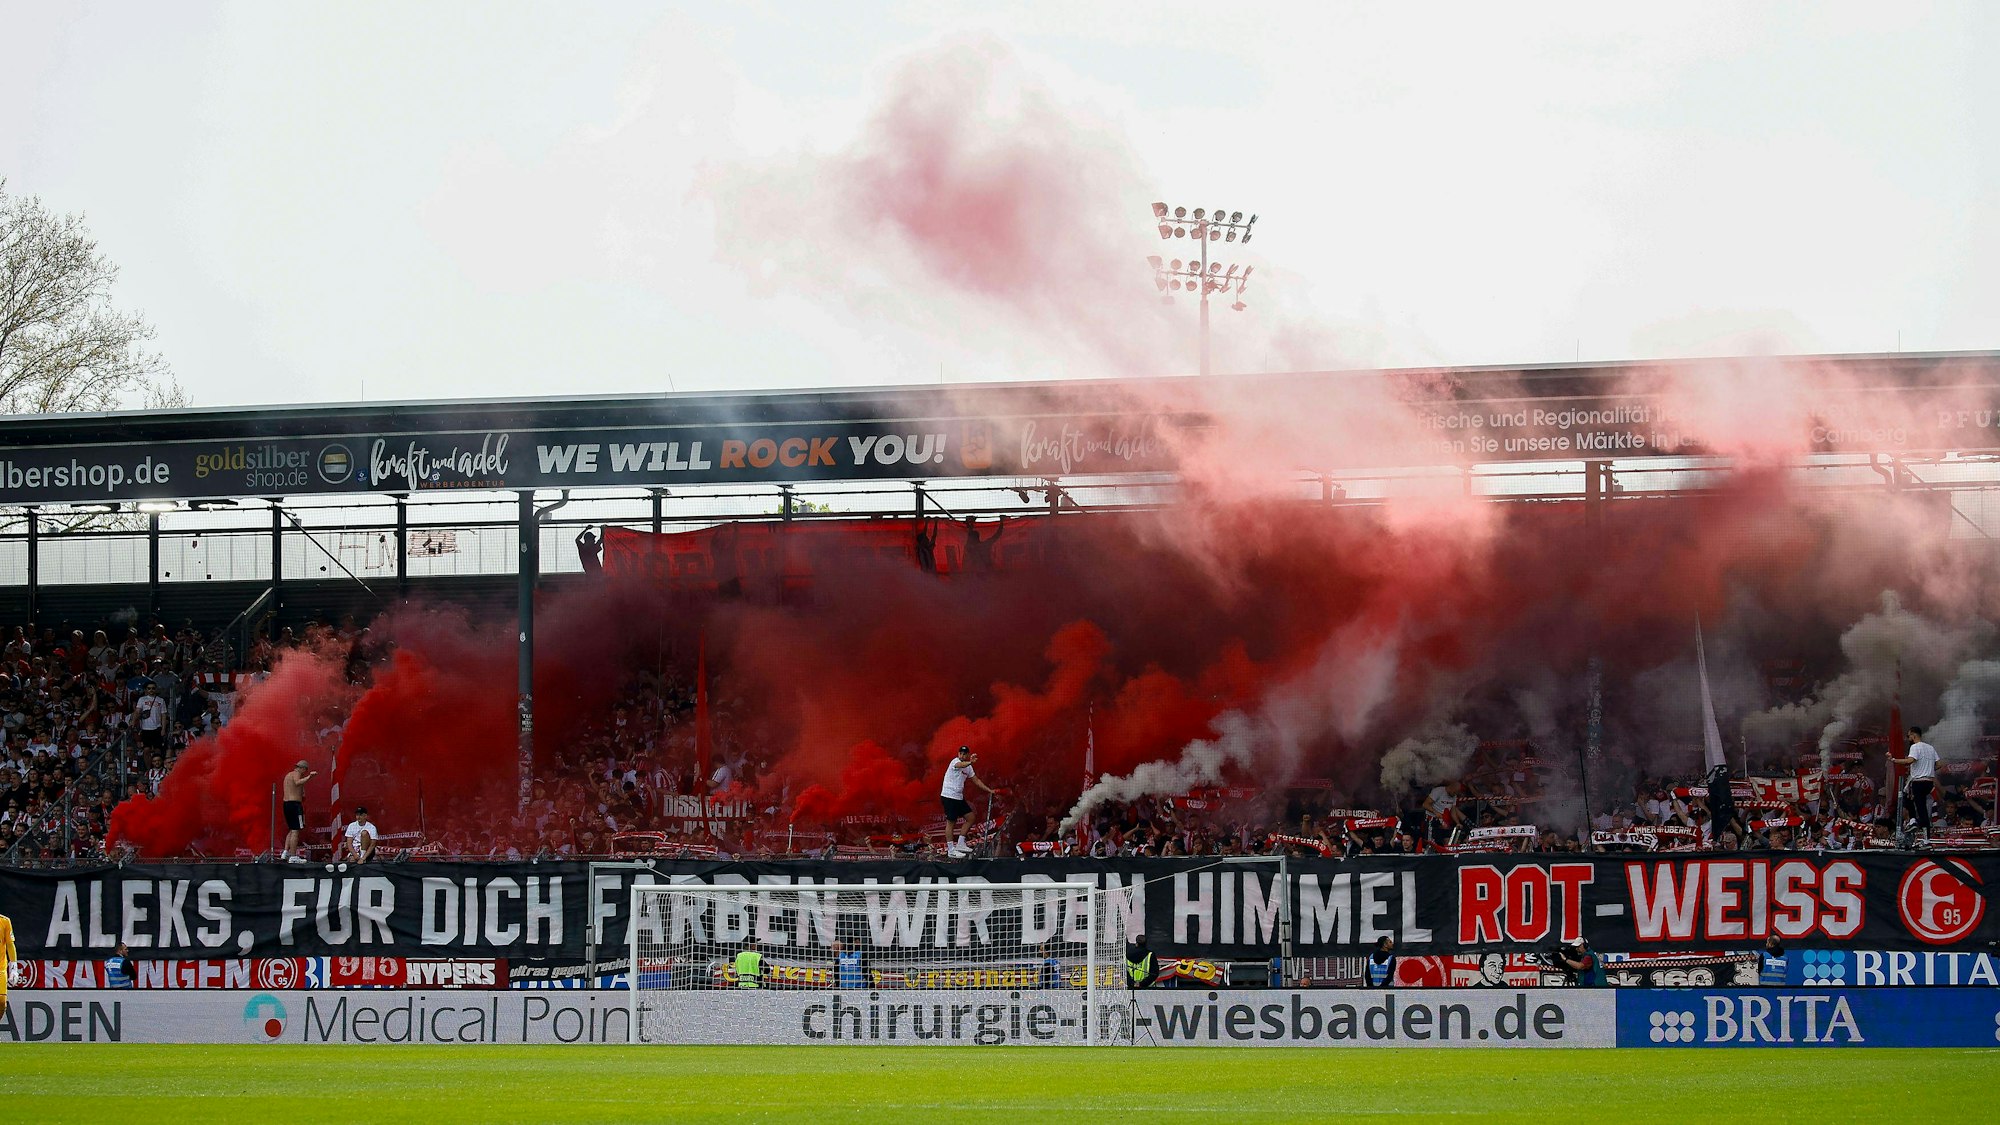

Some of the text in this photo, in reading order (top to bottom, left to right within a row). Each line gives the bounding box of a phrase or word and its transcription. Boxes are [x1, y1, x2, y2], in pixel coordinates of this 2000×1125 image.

[1417, 411, 1484, 429] Frische
[1490, 408, 1527, 427] und
[1533, 405, 1651, 430] Regionalität
[1937, 410, 2000, 428] PFU
[1470, 435, 1499, 453] Sie
[1504, 435, 1570, 452] unsere
[1576, 430, 1646, 450] Märkte
[1651, 430, 1669, 448] in
[1809, 427, 1908, 446] Camberg
[195, 444, 311, 478] goldsilber
[370, 432, 510, 491] kraft und adel
[536, 433, 948, 474] WE WILL ROCK YOU!
[246, 466, 308, 490] shop.de
[420, 480, 506, 489] WERBEAGENTUR
[45, 859, 1867, 956] ALEKS, FÜR DICH FARBEN WIR DEN HIMMEL ROT-WEISS
[1943, 908, 1961, 925] 95
[406, 962, 496, 985] HYPERS
[510, 965, 550, 978] ultras
[1853, 950, 1999, 986] BRITA
[277, 976, 288, 986] 95
[303, 995, 653, 1043] Medical Point
[801, 991, 1565, 1046] chirurgie-in-wiesbaden.de
[1703, 995, 1866, 1043] BRITA
